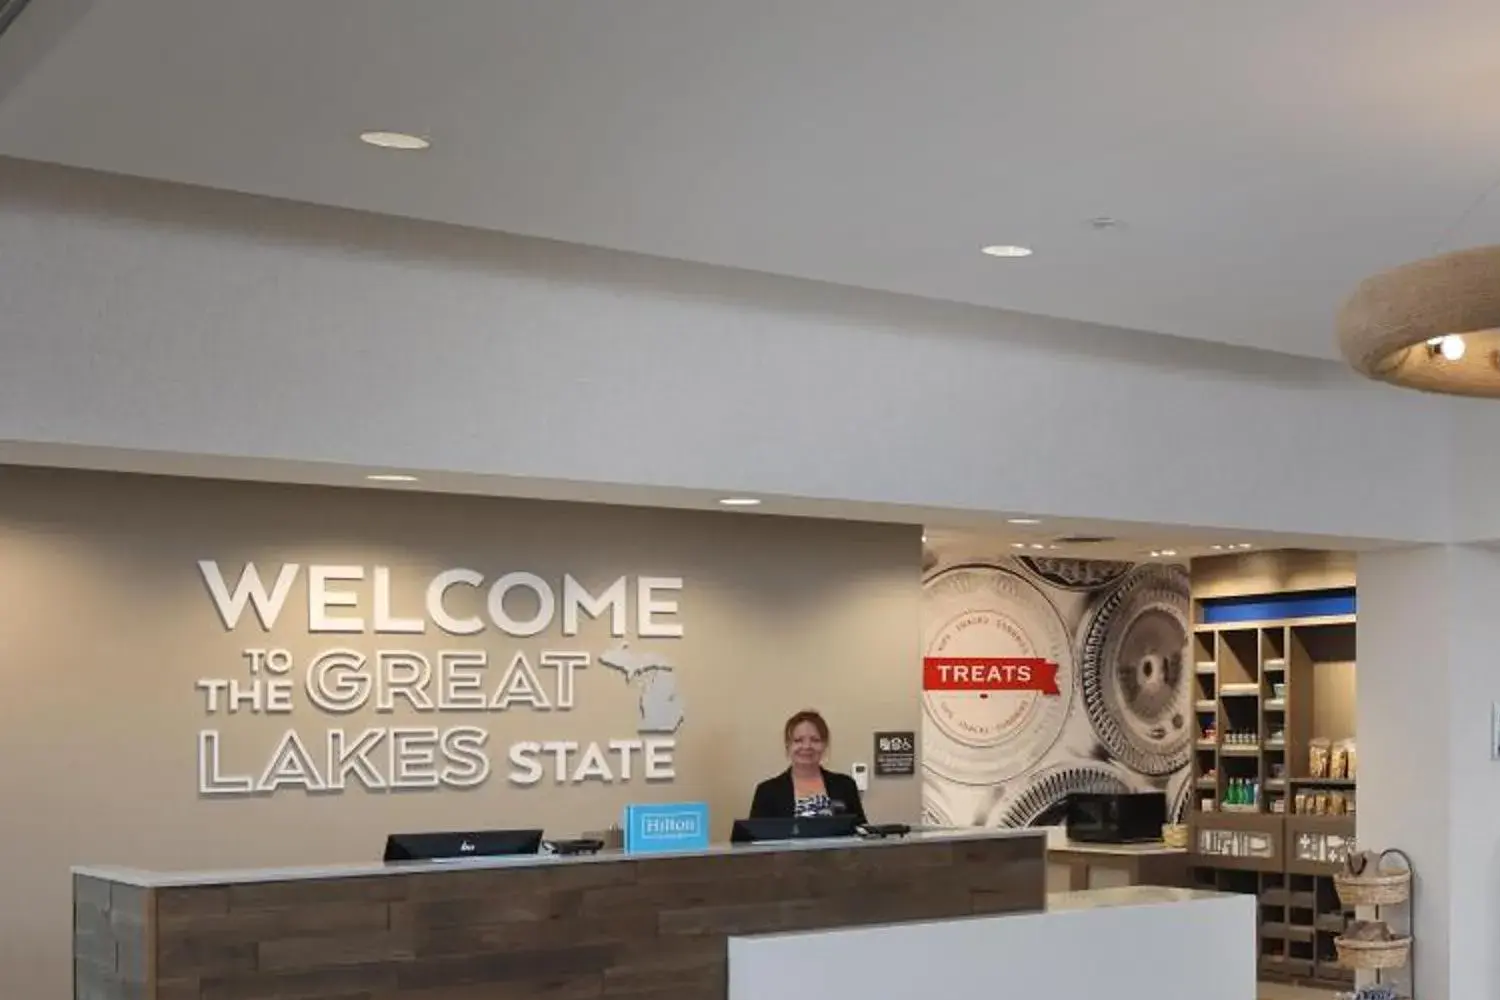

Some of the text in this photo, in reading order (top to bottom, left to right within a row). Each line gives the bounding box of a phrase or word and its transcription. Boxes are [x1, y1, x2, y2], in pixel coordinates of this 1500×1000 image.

[198, 560, 684, 638] WELCOME
[197, 648, 592, 714] THE GREAT
[243, 648, 293, 674] TO
[937, 664, 1032, 683] TREATS
[199, 725, 676, 793] LAKES STATE
[646, 817, 696, 833] Hilton
